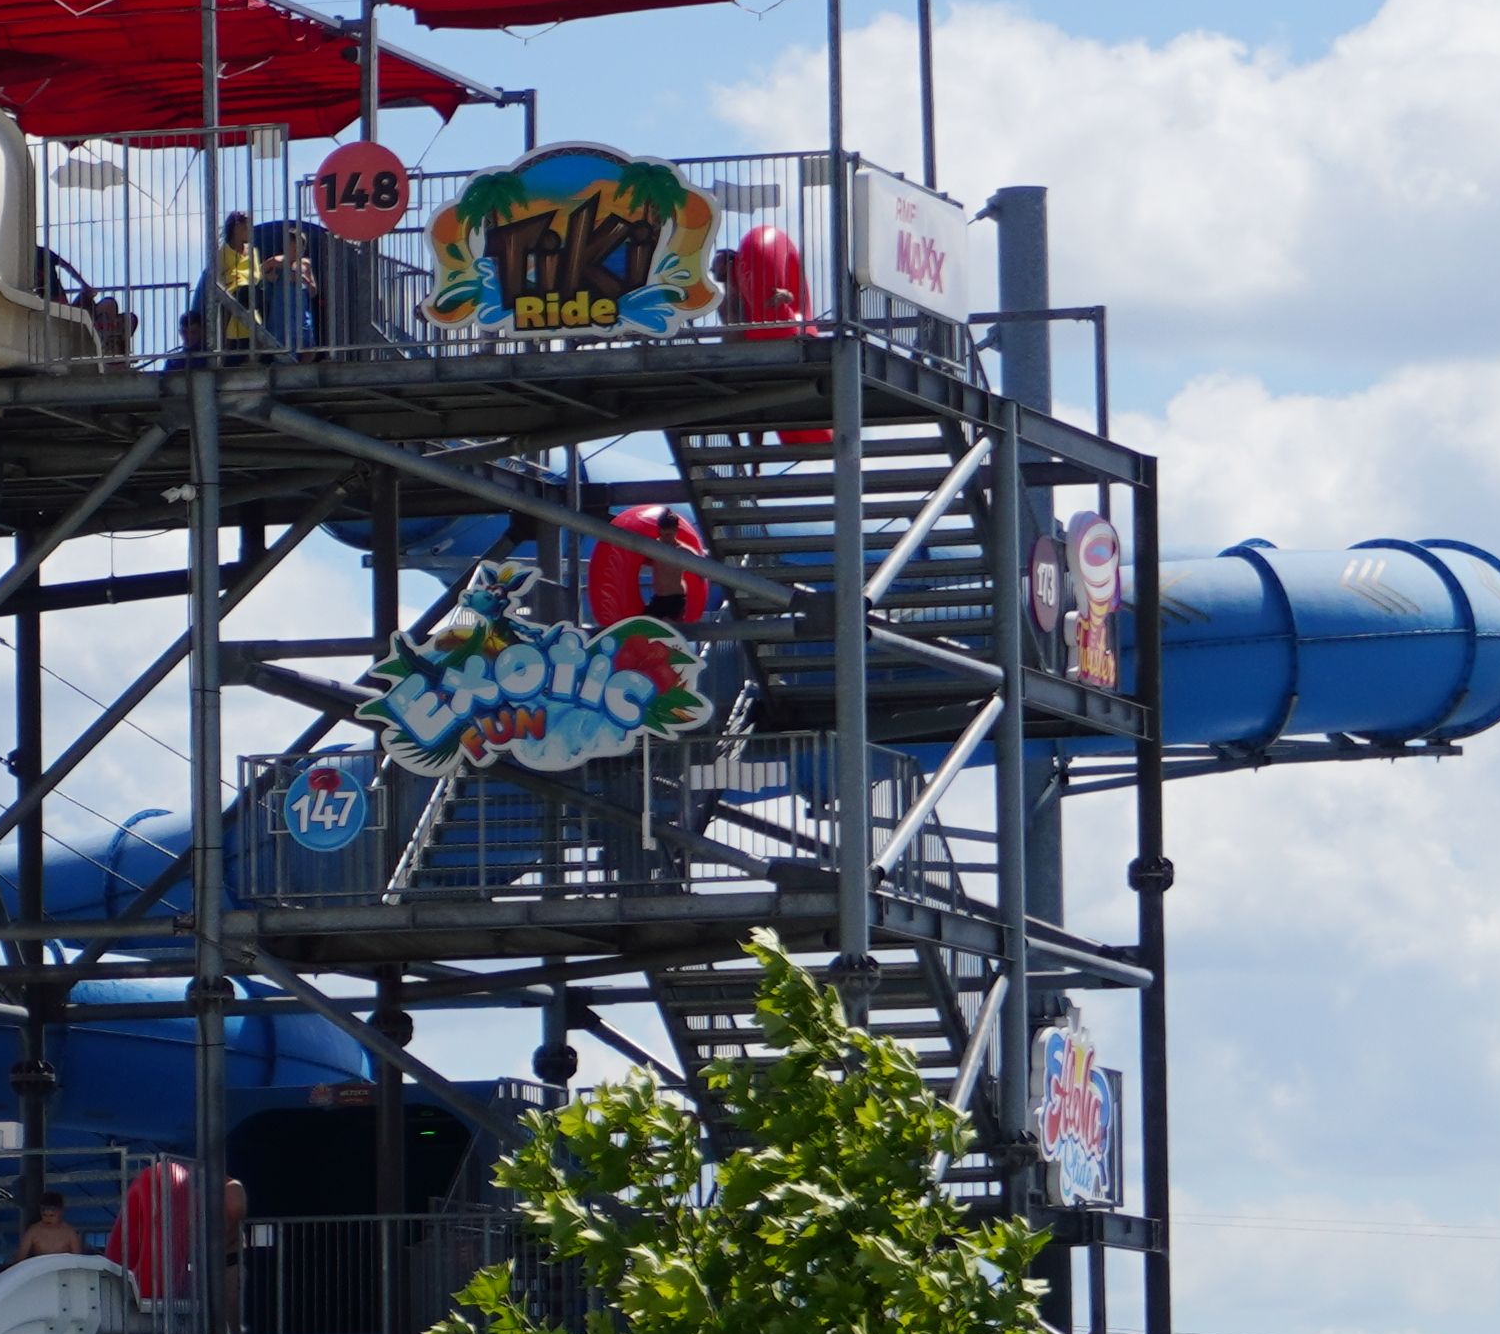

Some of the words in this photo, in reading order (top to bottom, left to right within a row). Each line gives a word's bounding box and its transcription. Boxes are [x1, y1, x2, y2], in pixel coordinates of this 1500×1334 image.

[319, 170, 399, 212] 148
[514, 290, 618, 330] Ride
[1036, 562, 1056, 606] 173
[461, 706, 546, 760] FUN
[290, 789, 357, 833] 147
